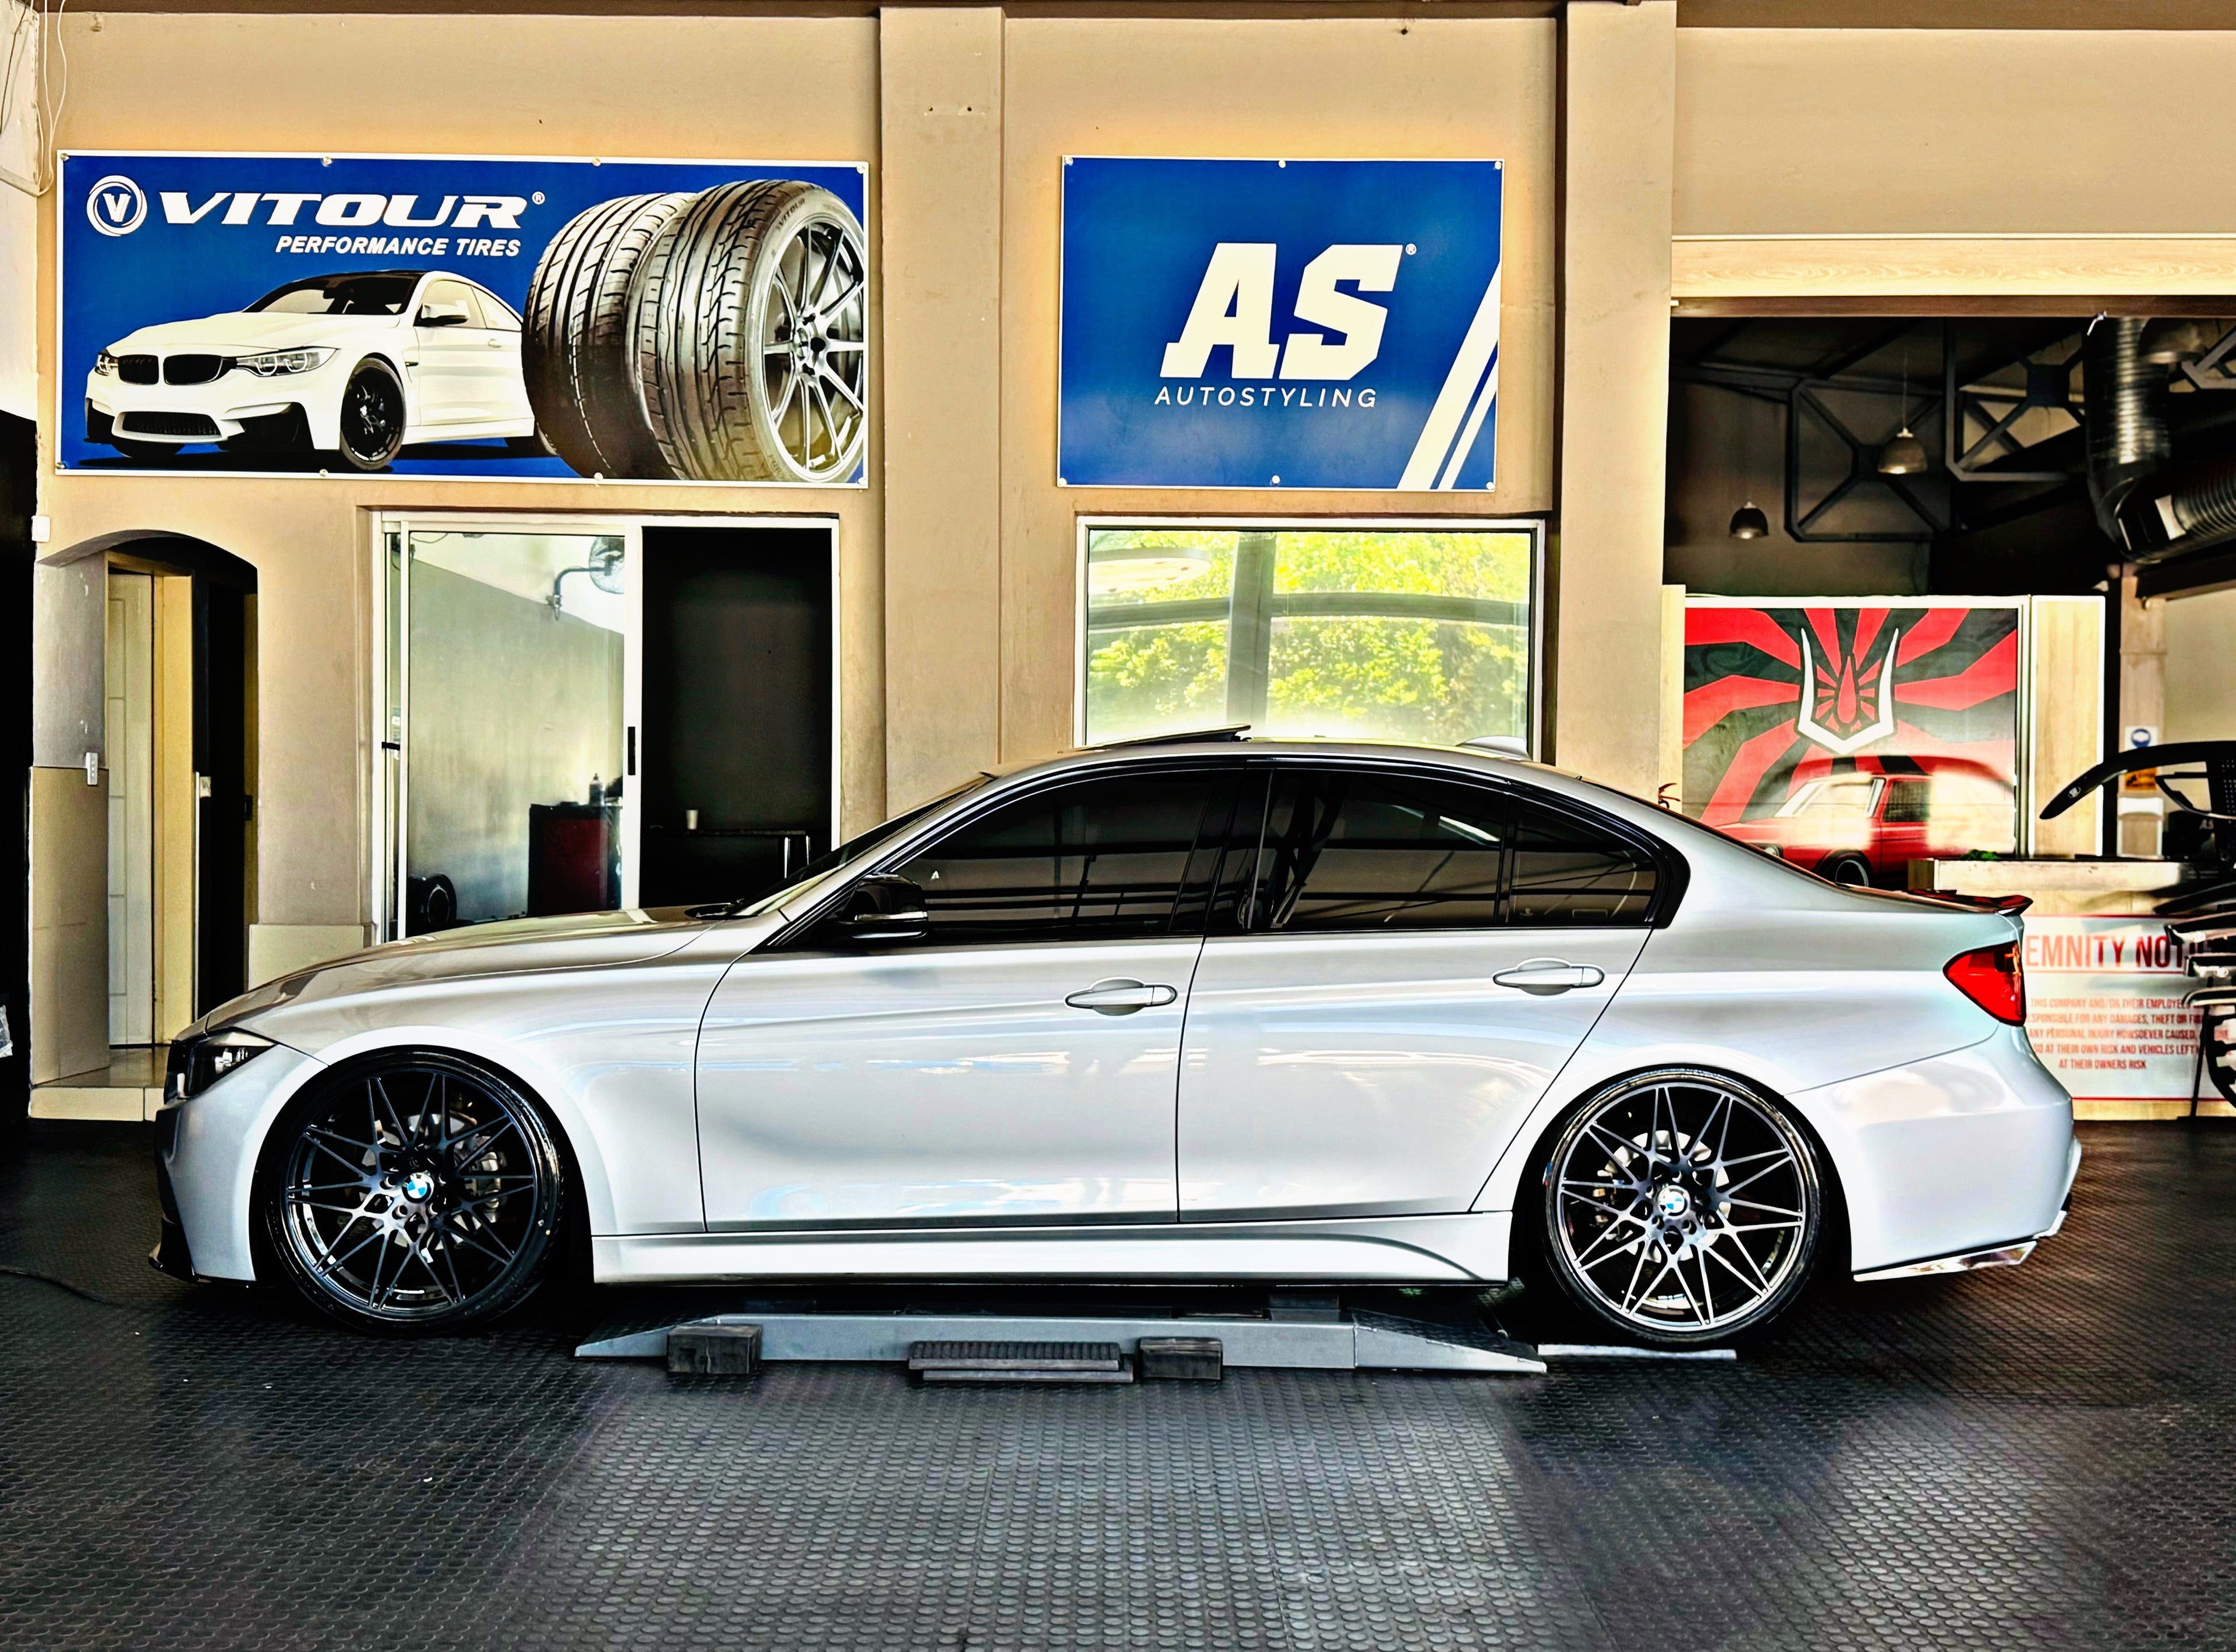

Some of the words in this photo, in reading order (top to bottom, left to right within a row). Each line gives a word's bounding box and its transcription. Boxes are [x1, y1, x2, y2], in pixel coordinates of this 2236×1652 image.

[159, 192, 528, 229] VITOUR
[275, 235, 449, 256] PERFORMANCE
[457, 238, 521, 257] TIRES
[1160, 243, 1403, 380] AS
[1154, 386, 1377, 408] AUTOSTYLING
[2049, 998, 2086, 1007] COMPANY
[2122, 998, 2144, 1008] THEIR
[2076, 1013, 2090, 1023] FOR
[2093, 1013, 2107, 1023] ANY
[2152, 1014, 2174, 1024] THEFT
[2177, 1014, 2187, 1024] OR
[2029, 1028, 2043, 1038] ANY
[2046, 1028, 2085, 1038] PERSONAL
[2088, 1029, 2114, 1038] INJURY
[2045, 1043, 2054, 1053] AT
[2057, 1044, 2079, 1053] THEIR
[2081, 1044, 2099, 1053] OWN
[2100, 1044, 2118, 1053] RISK
[2120, 1044, 2136, 1054] AND
[2139, 1044, 2174, 1055] VEHICLES
[2058, 1059, 2068, 1069] AT
[2071, 1059, 2093, 1069] THEIR
[2095, 1059, 2127, 1069] OWNERS
[2129, 1059, 2146, 1069] RISK
